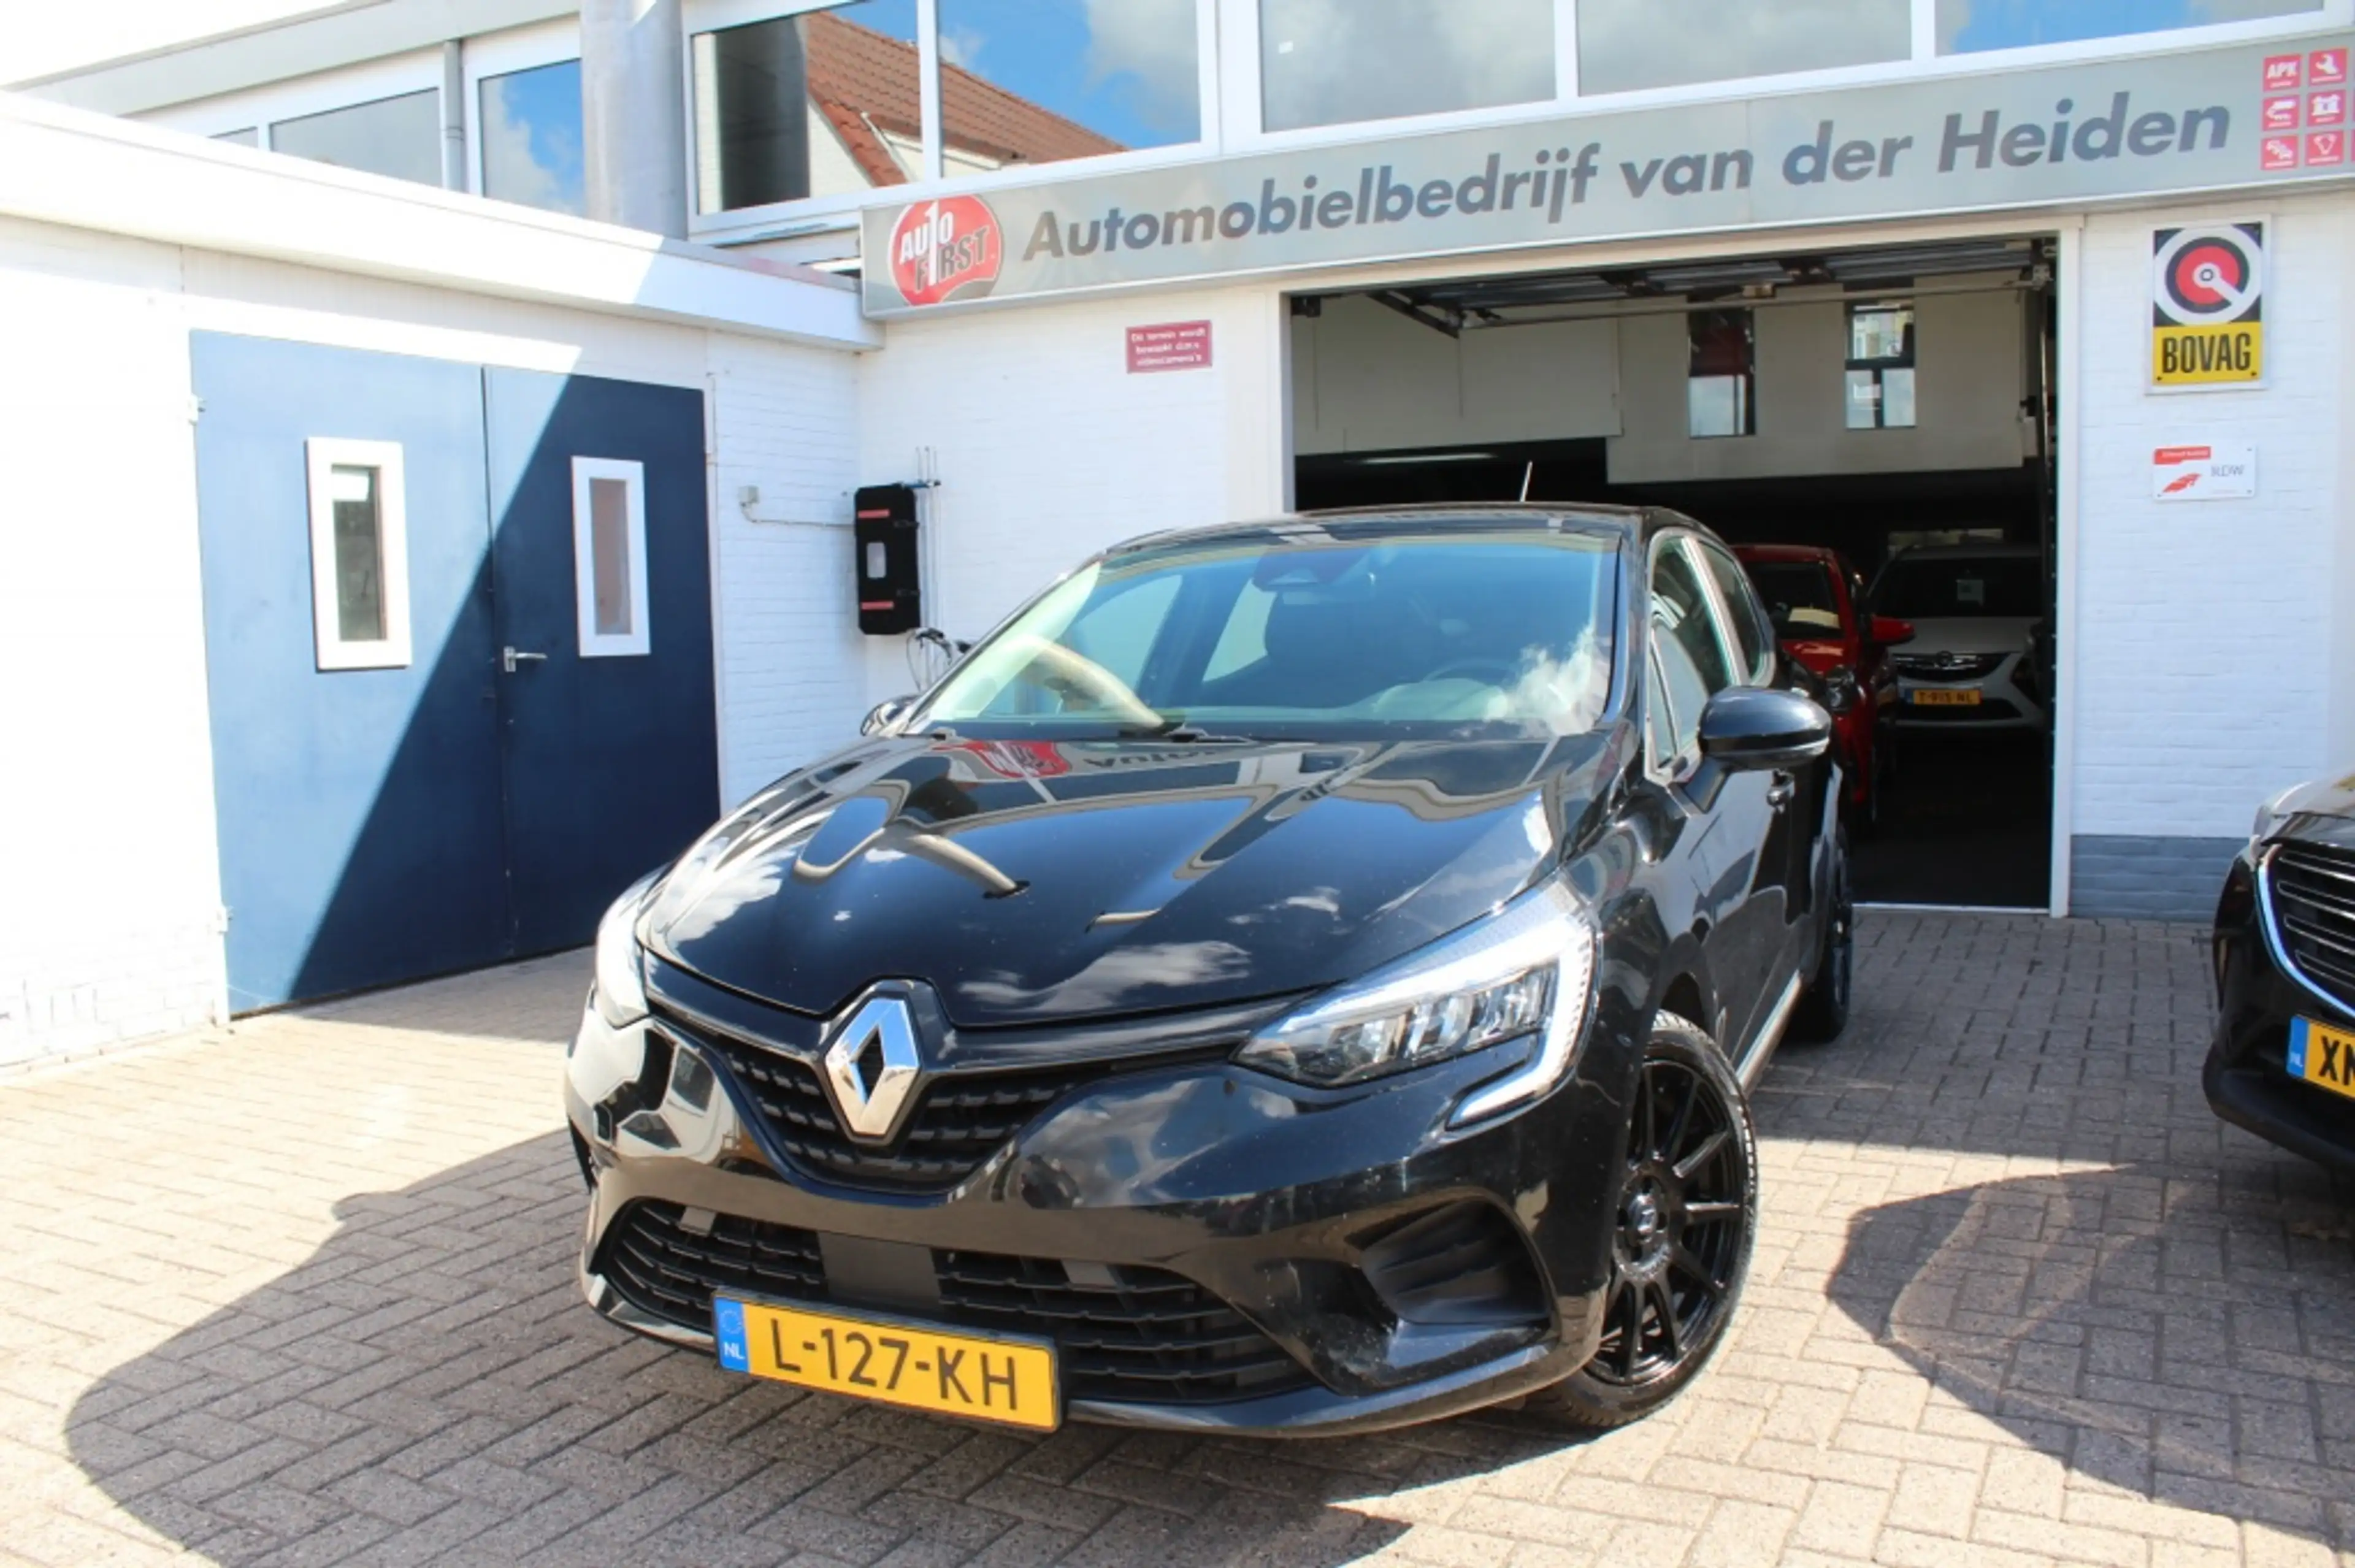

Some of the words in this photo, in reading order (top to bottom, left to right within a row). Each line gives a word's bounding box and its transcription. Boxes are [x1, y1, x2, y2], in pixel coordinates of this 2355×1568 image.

[1023, 143, 1601, 262] Automobielbedrijf
[1620, 148, 1753, 197] van
[1783, 120, 1913, 185] der
[1938, 91, 2231, 173] Heiden
[2162, 332, 2251, 373] BOVAG
[723, 1342, 746, 1360] NL
[770, 1318, 1017, 1410] L-127-KH
